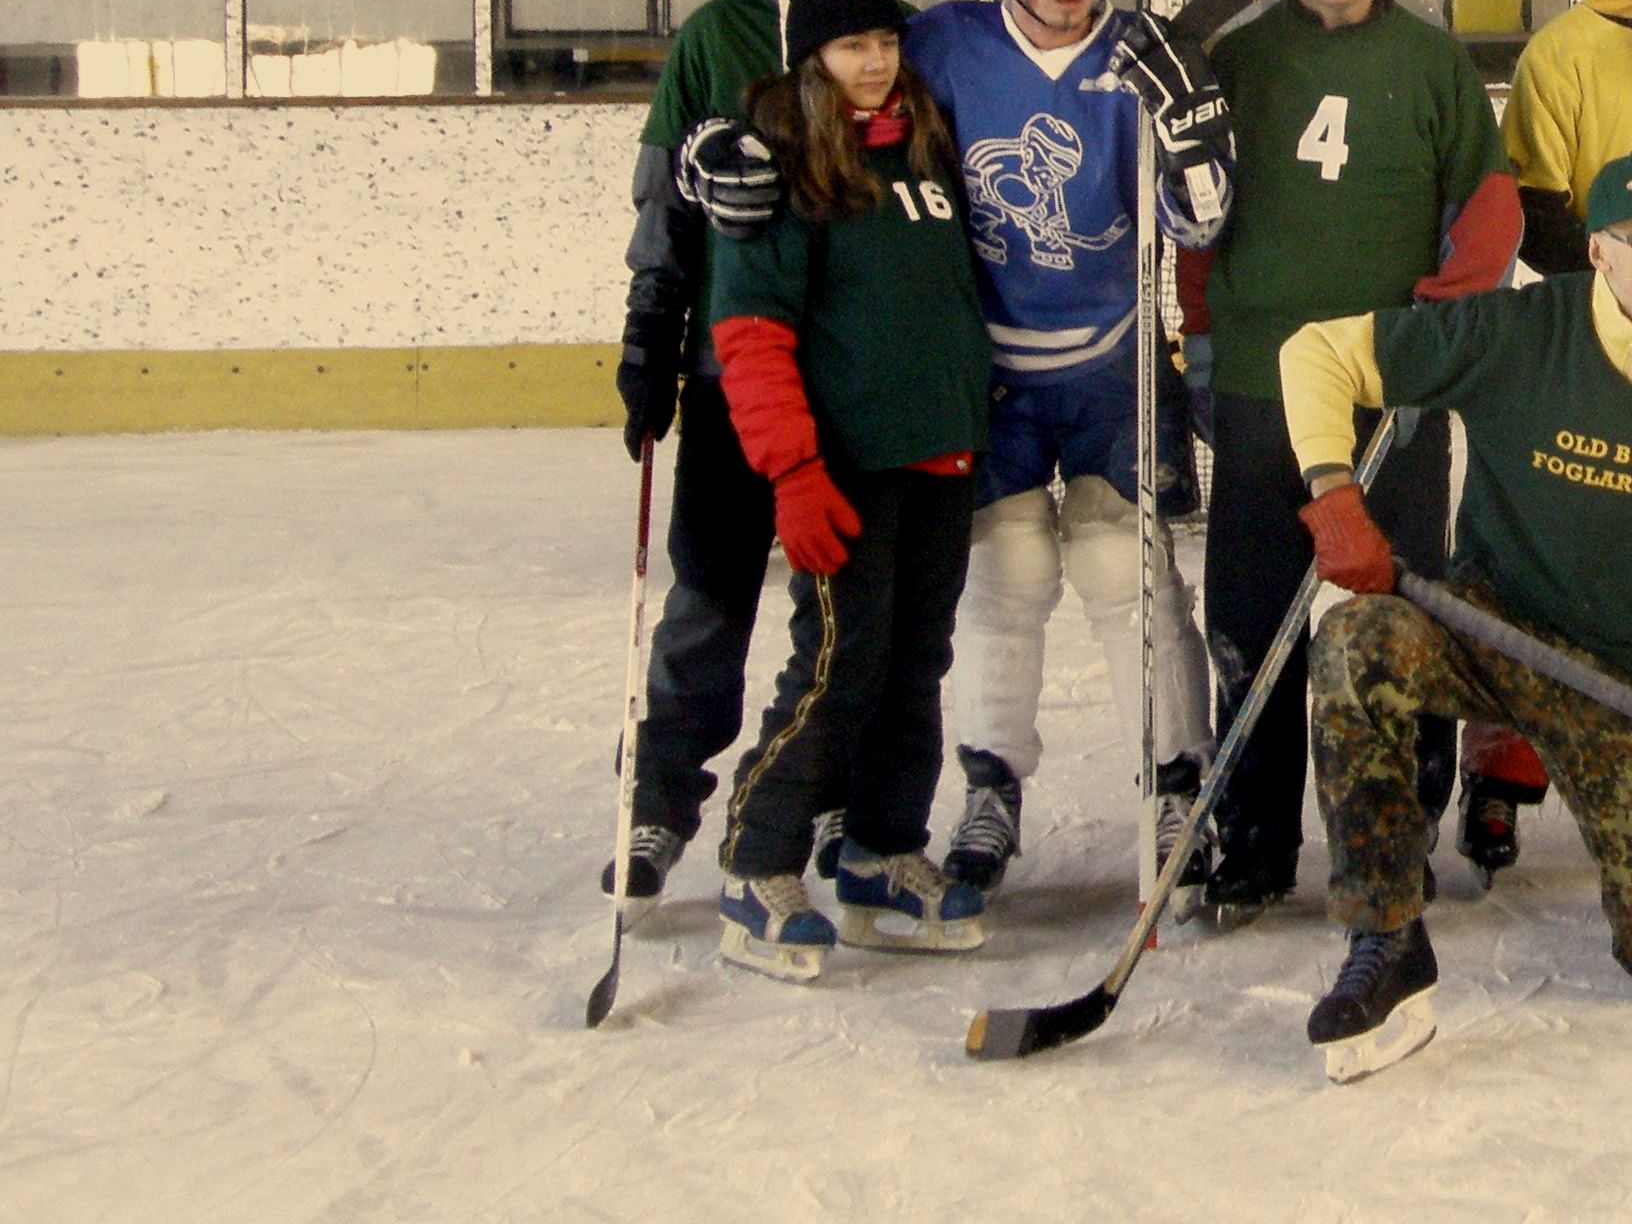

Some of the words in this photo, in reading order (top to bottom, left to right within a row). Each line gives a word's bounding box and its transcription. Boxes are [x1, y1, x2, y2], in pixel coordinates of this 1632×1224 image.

[1297, 95, 1349, 181] 4
[892, 180, 952, 221] 16
[1556, 430, 1609, 459] OLD
